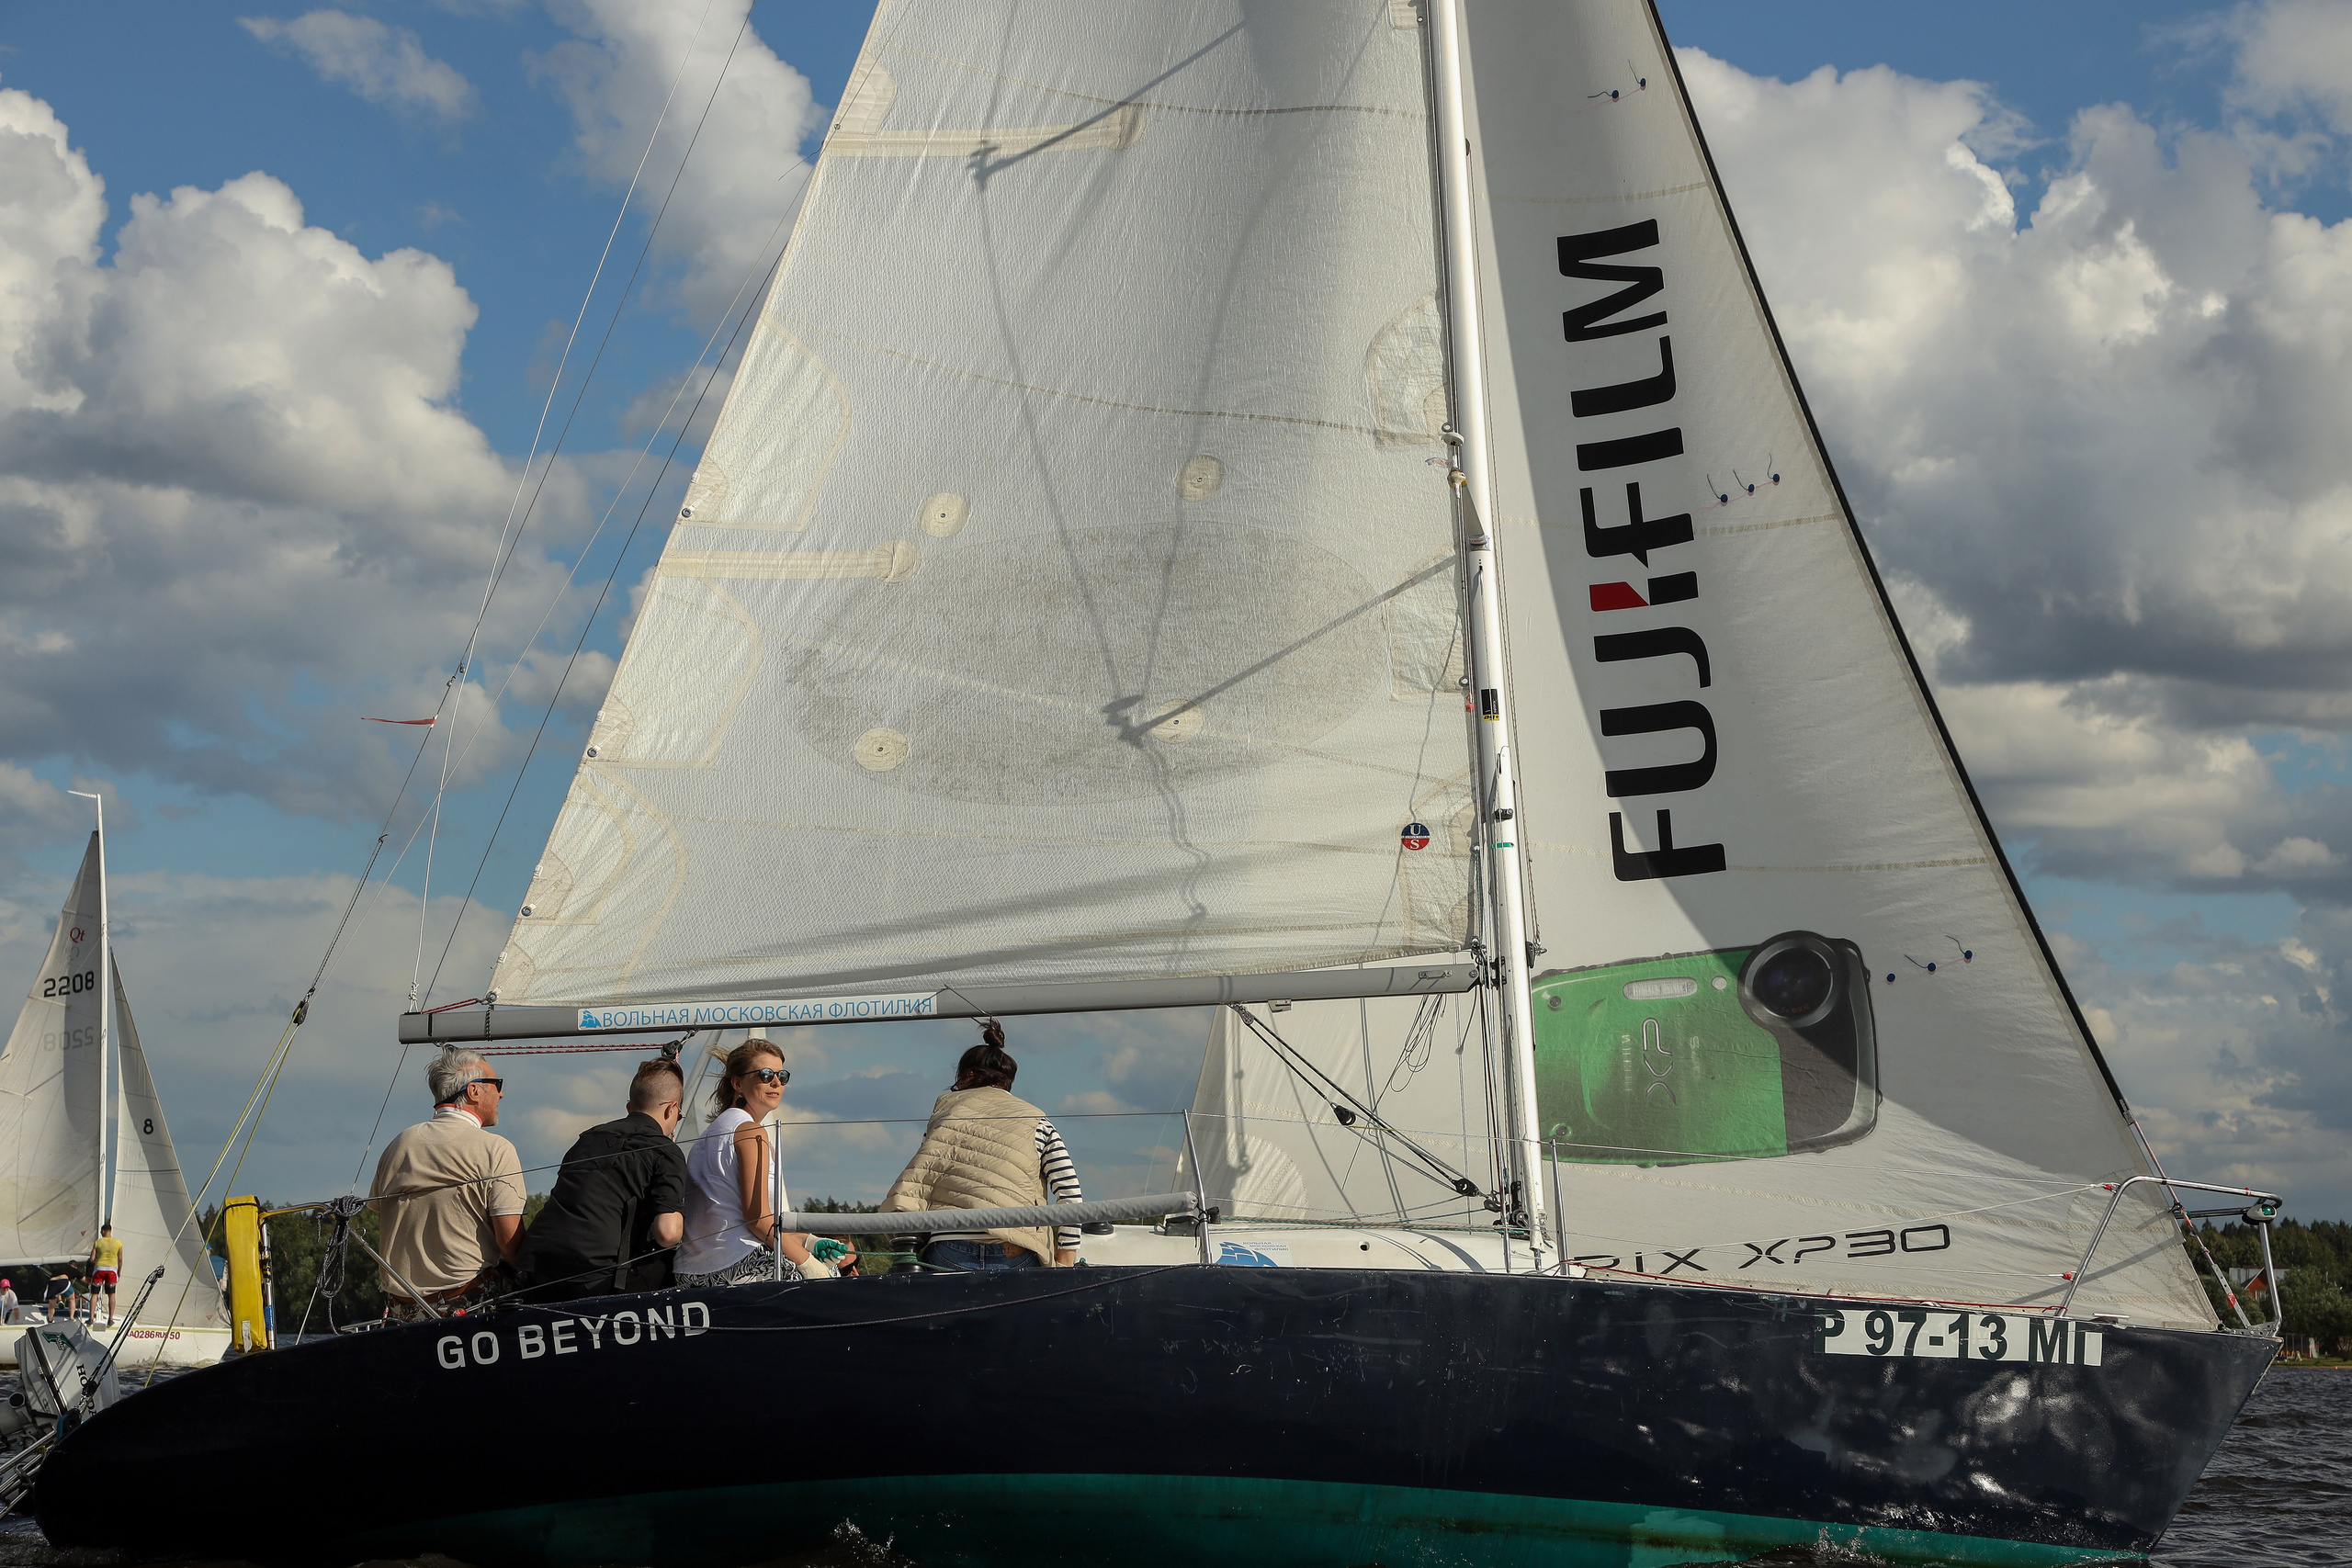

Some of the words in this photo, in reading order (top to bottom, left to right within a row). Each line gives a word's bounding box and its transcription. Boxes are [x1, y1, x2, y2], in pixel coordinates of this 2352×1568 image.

[1556, 219, 1727, 882] FUJIFILM
[43, 970, 95, 998] 2208
[603, 1007, 690, 1028] ВОЛЬНАЯ
[695, 1001, 823, 1024] МОСКОВСКАЯ
[828, 998, 933, 1018] ФЛОТИЛИЯ
[143, 1118, 154, 1135] 8
[1738, 1224, 1951, 1270] XP30
[435, 1331, 501, 1370] GO
[517, 1301, 710, 1359] BEYOND
[1864, 1310, 2008, 1359] 97-13
